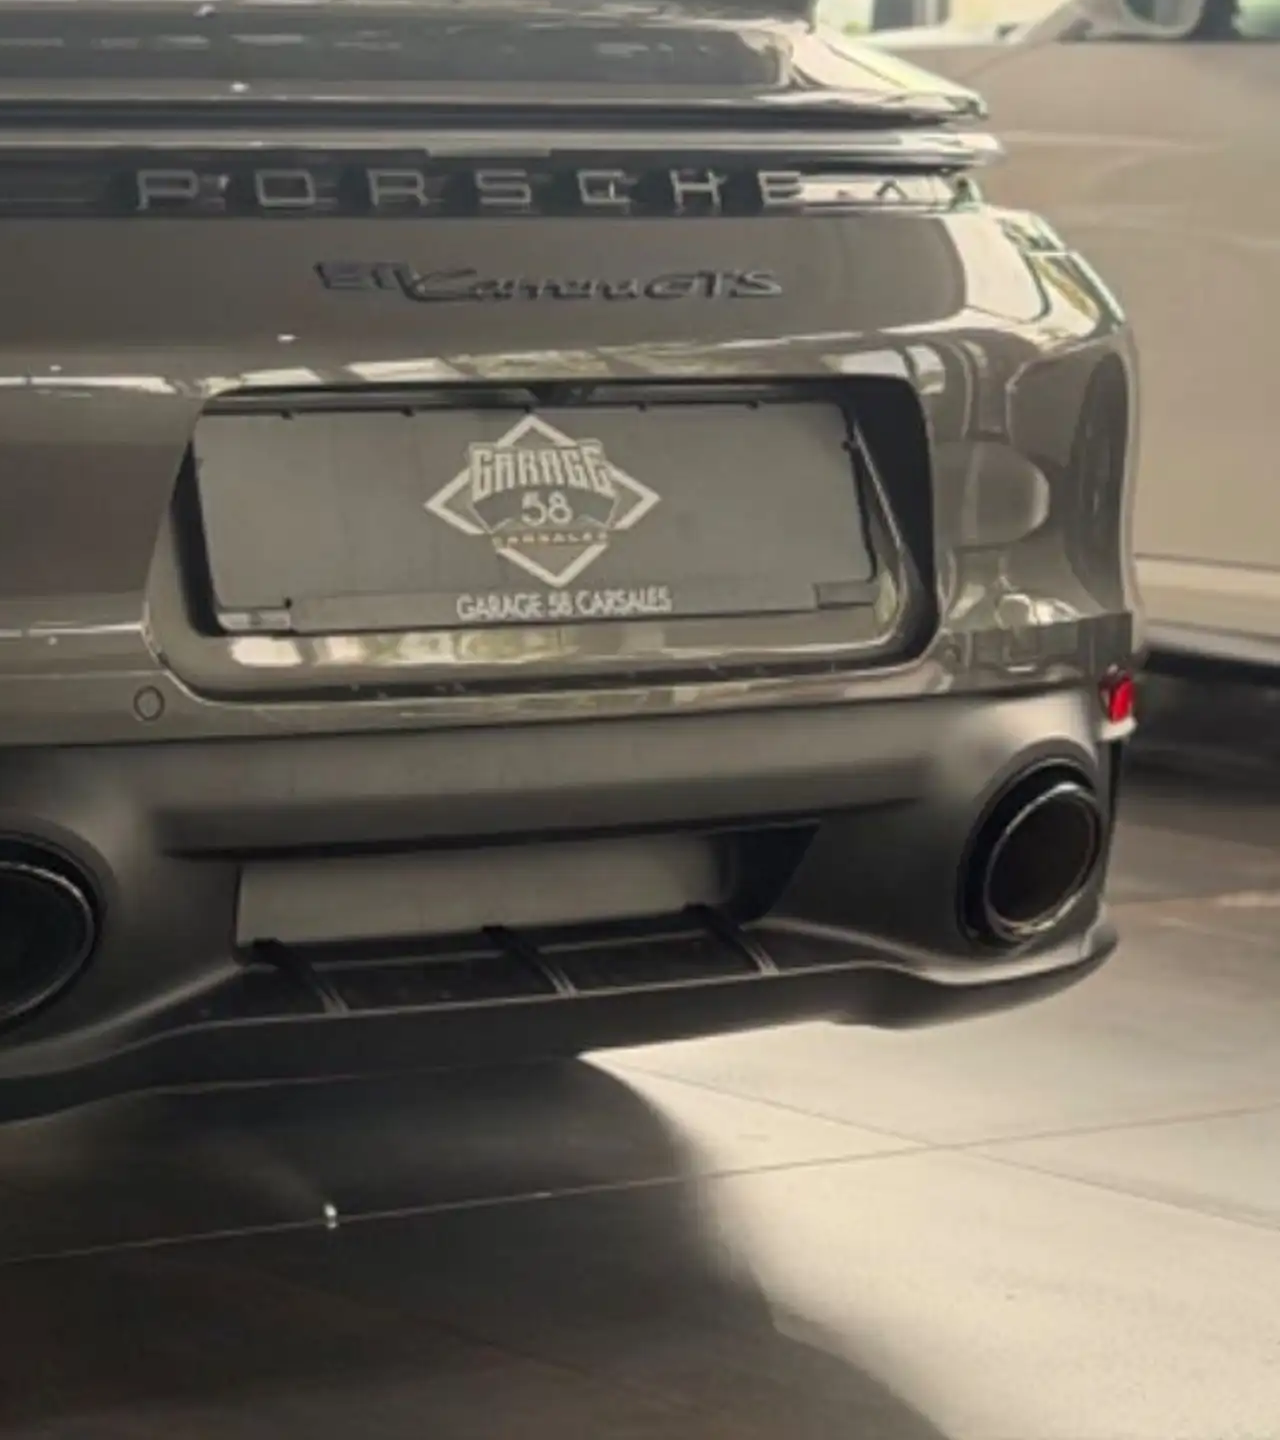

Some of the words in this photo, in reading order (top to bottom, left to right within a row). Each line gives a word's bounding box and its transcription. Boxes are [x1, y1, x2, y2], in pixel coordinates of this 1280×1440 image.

[134, 167, 806, 214] PORSCHE
[643, 269, 784, 301] GTS
[471, 444, 615, 501] GARAGE
[521, 491, 572, 526] 58
[456, 592, 542, 621] GARAGE
[547, 590, 573, 618] 58
[575, 585, 673, 617] CARSALES
